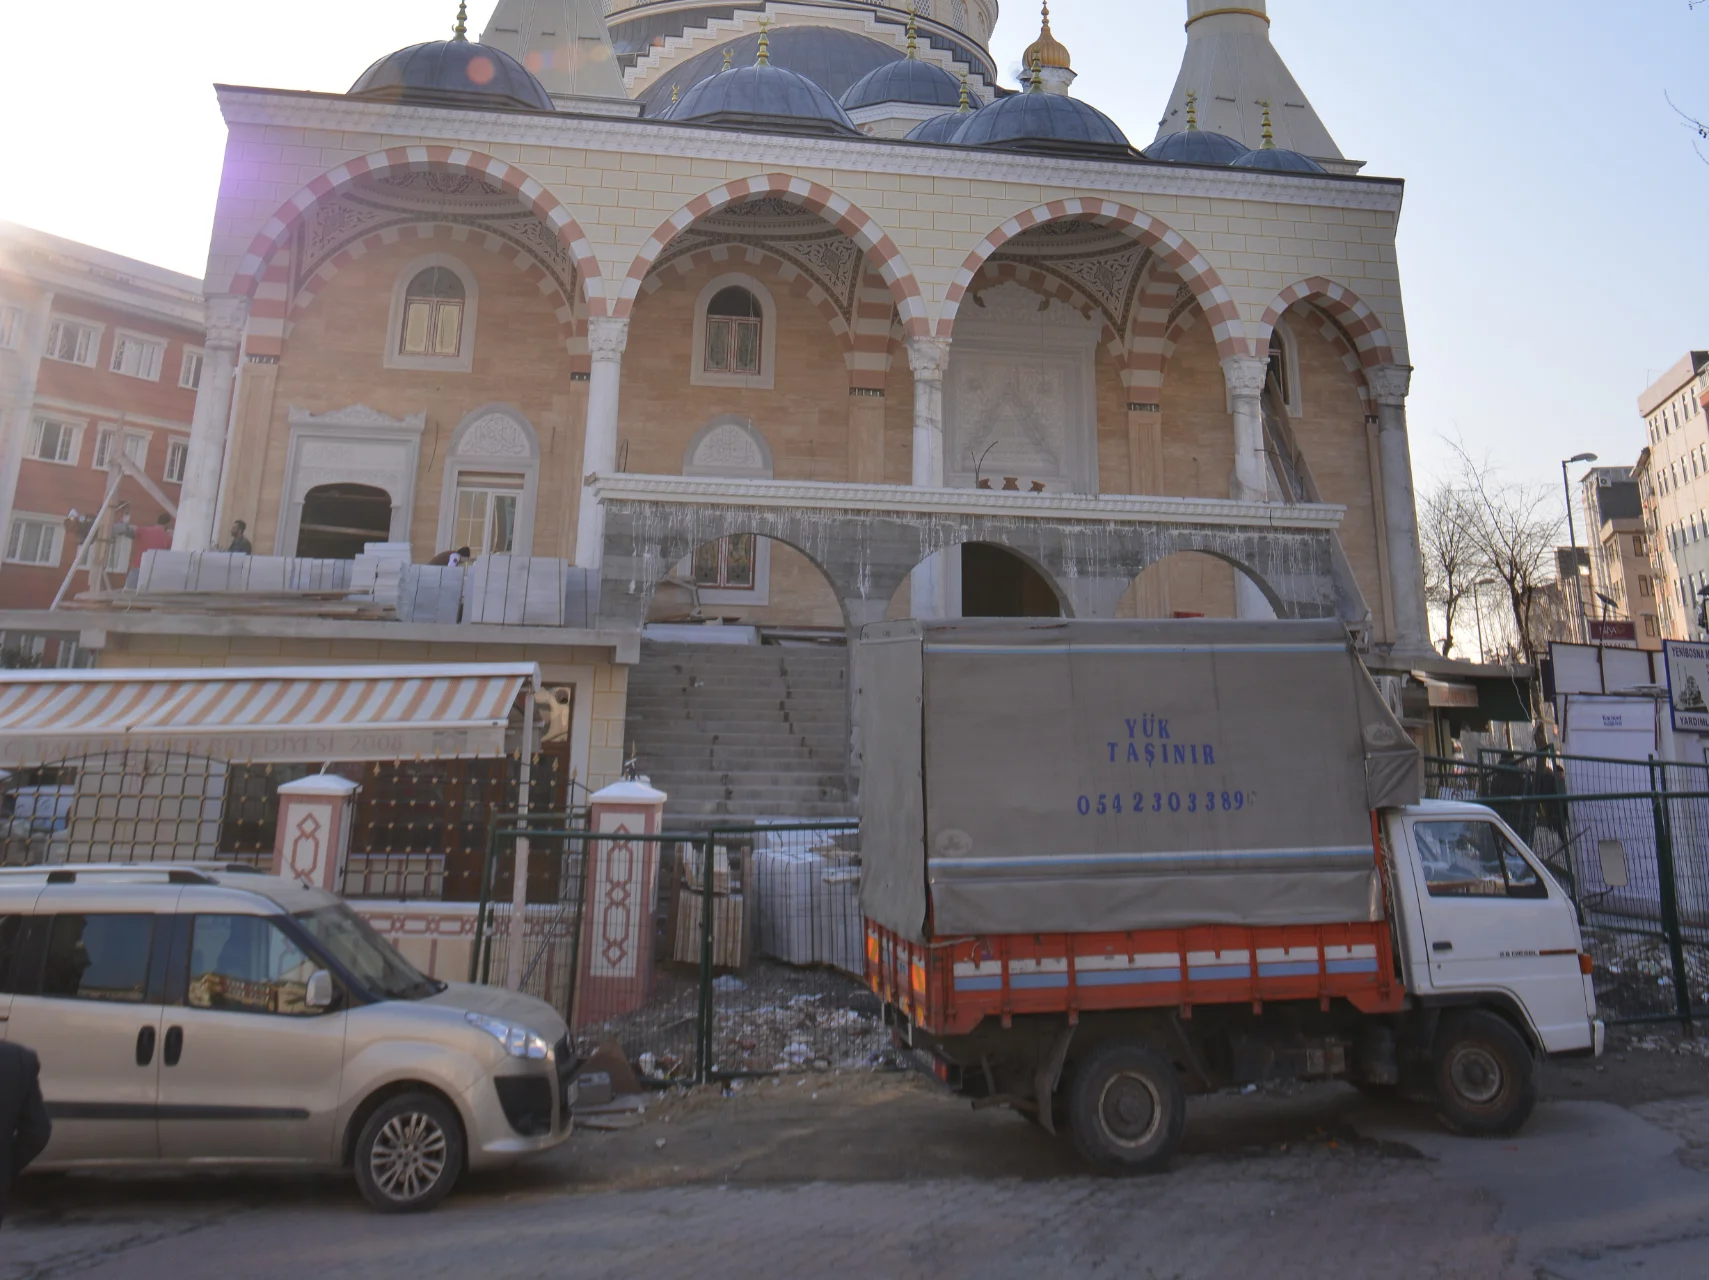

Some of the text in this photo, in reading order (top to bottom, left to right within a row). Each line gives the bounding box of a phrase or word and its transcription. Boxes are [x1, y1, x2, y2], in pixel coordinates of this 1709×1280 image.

[1125, 713, 1170, 739] YÜK
[349, 733, 404, 752] 2008
[1107, 742, 1216, 768] TAŞINIR
